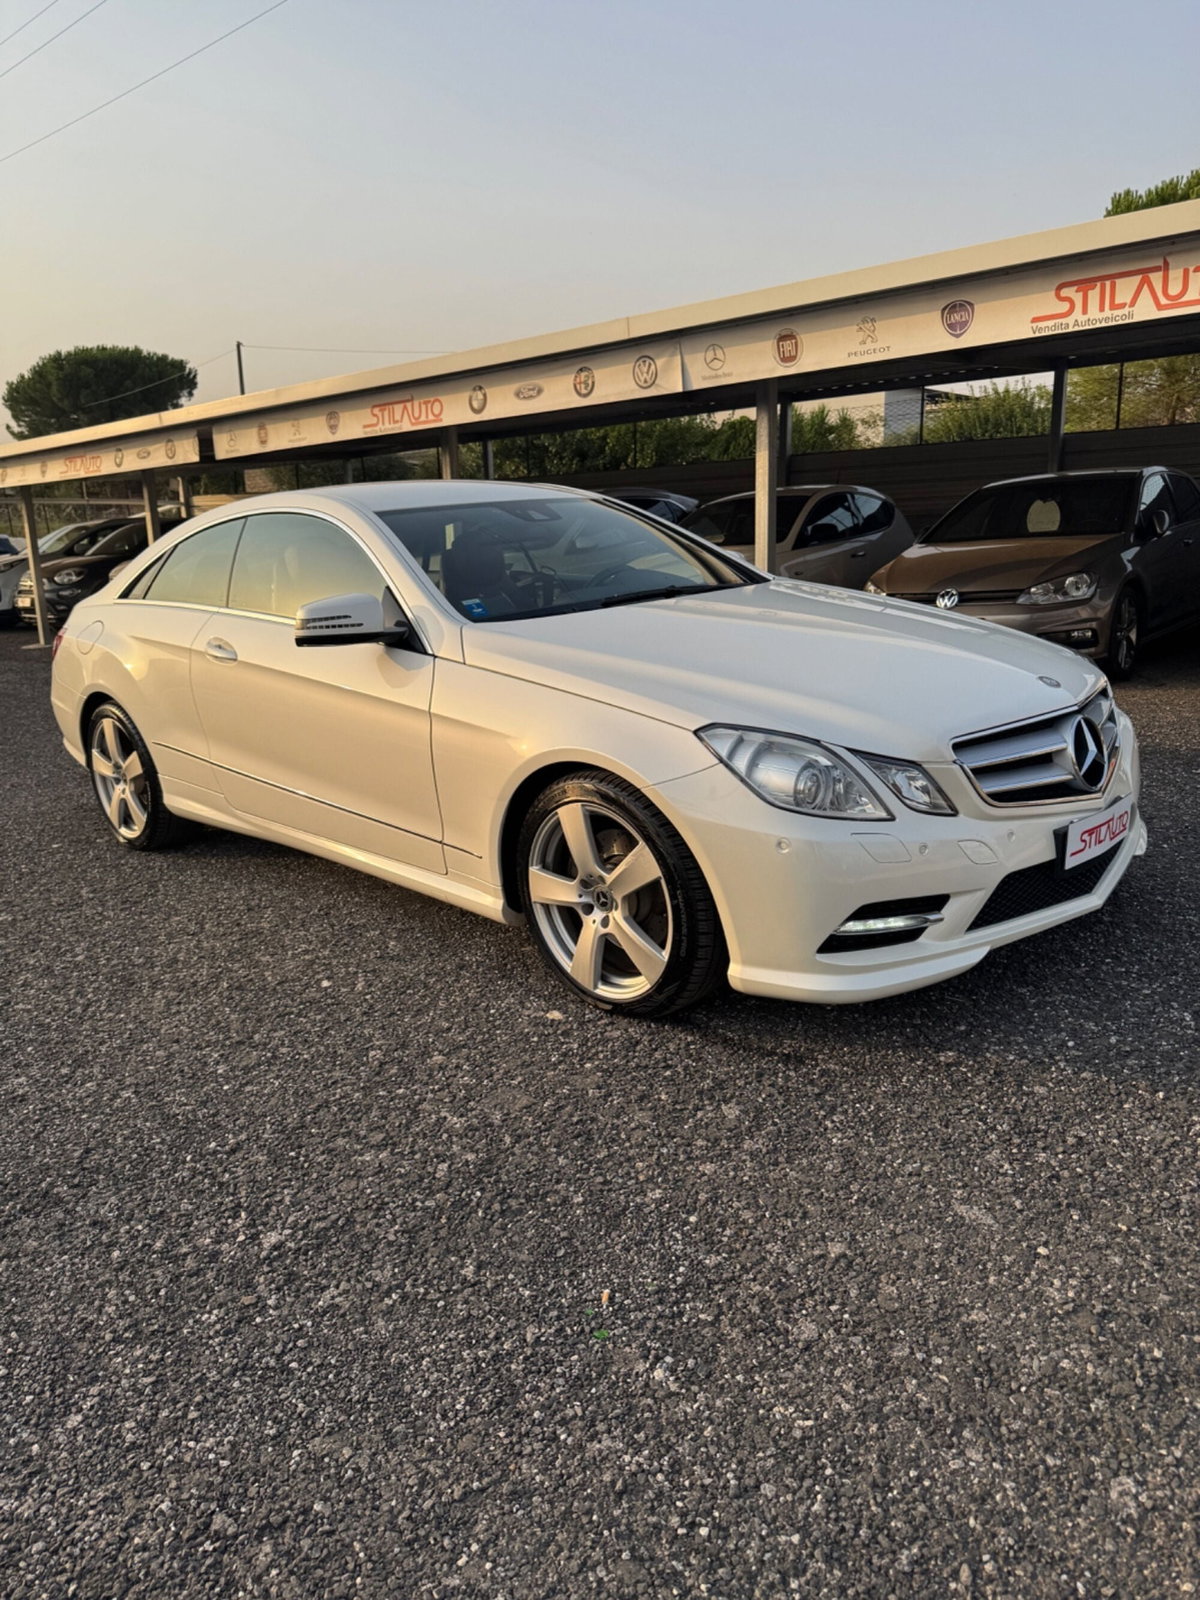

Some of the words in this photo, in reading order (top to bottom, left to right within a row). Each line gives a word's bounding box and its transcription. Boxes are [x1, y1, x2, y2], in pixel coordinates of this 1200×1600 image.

[946, 311, 969, 324] LANCIA
[1031, 321, 1070, 335] Vendita
[1072, 310, 1134, 329] Autoveicoli
[779, 339, 796, 359] FIAT
[847, 345, 892, 358] PEUGEOT
[363, 394, 444, 426] STILAUTO
[1070, 810, 1129, 857] STILAUTO
